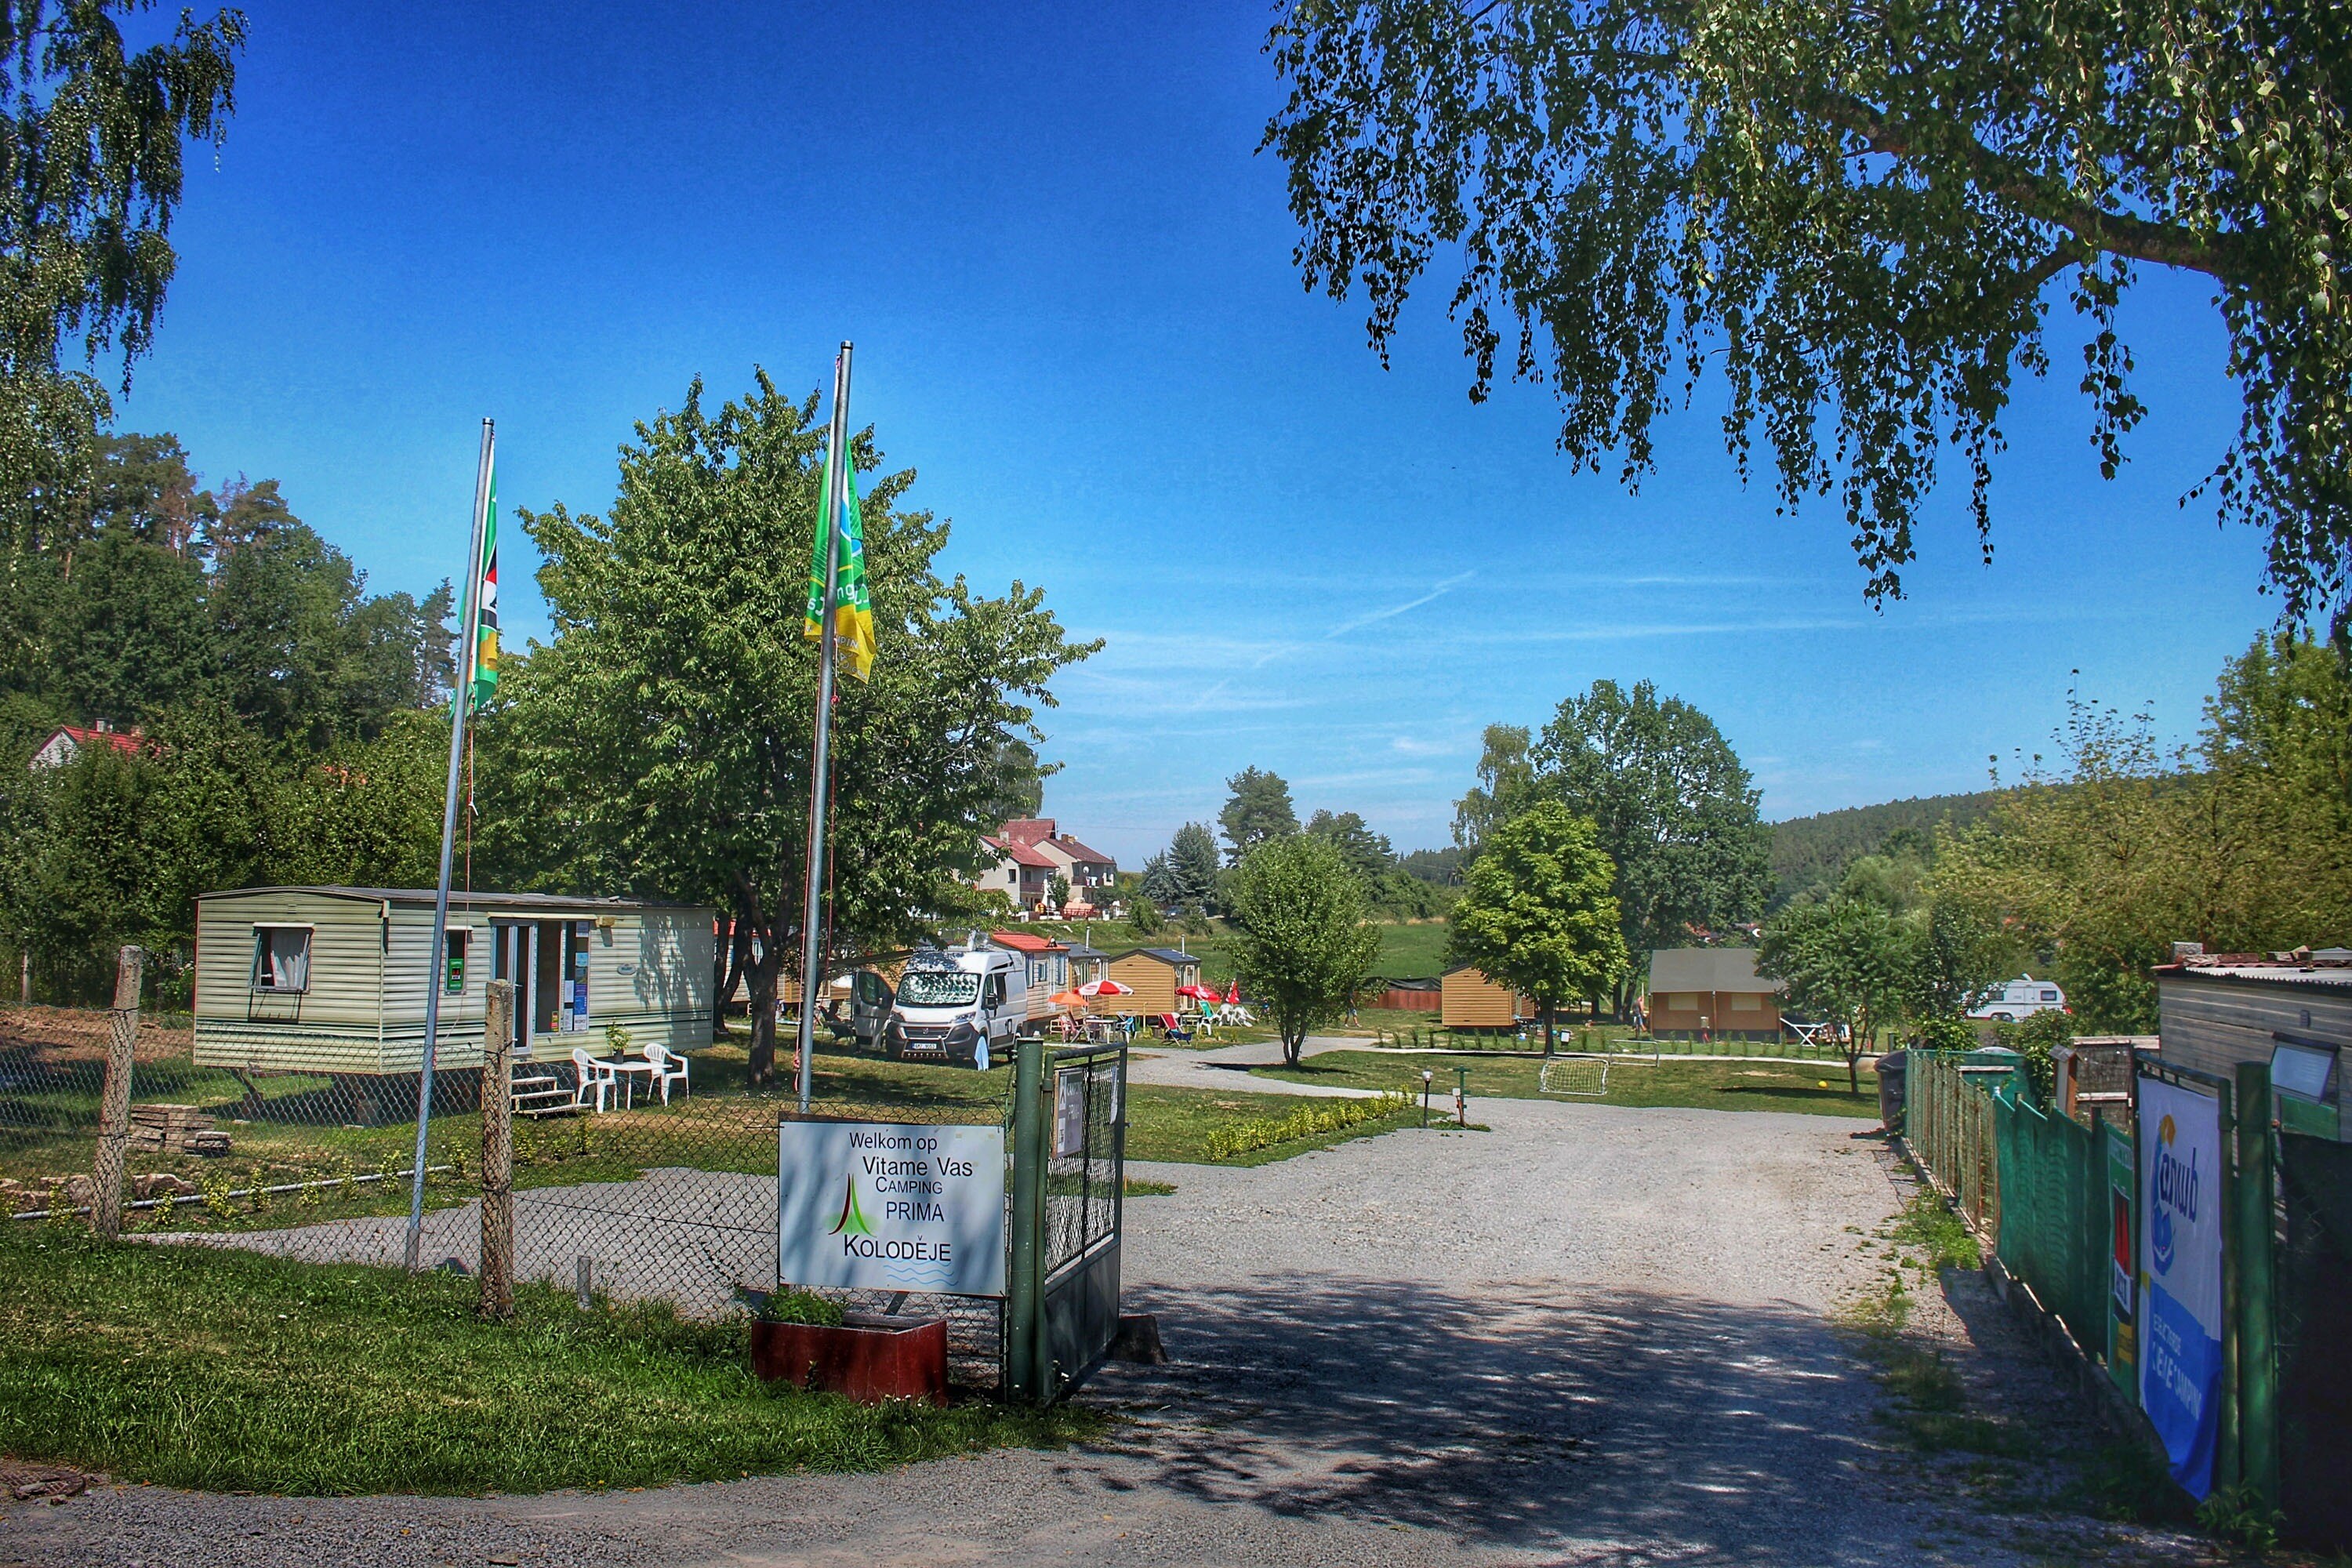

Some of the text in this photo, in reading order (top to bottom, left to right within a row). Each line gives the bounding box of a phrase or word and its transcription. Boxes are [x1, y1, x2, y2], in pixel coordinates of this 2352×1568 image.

[849, 1132, 938, 1154] Welkom op
[862, 1156, 973, 1177] Vitame Vas
[876, 1176, 943, 1195] CAMPING
[2159, 1146, 2198, 1223] anwb
[886, 1201, 945, 1222] PRIMA
[844, 1233, 952, 1261] KOLODĚJE
